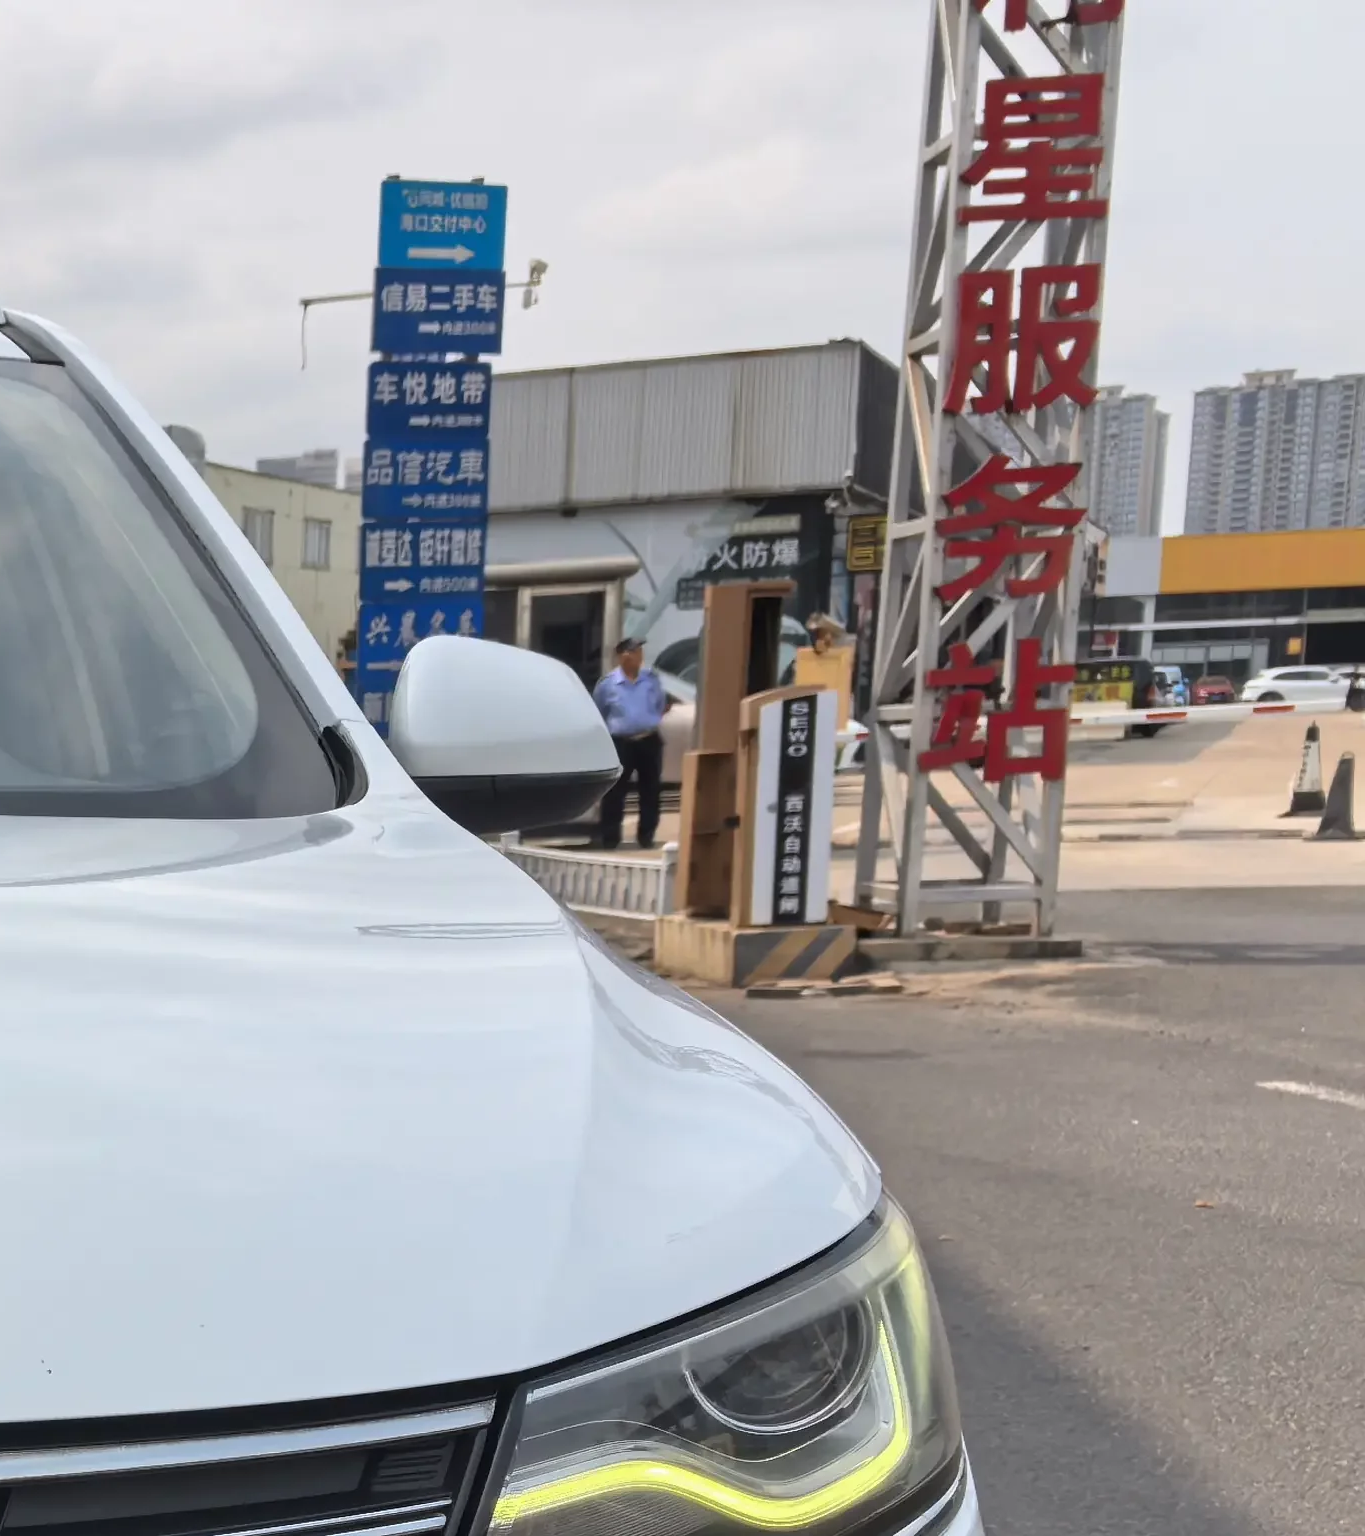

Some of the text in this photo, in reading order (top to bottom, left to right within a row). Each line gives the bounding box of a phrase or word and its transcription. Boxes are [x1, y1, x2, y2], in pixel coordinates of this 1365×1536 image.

[381, 282, 498, 313] 信易二手车
[373, 371, 486, 406] 车悦地带
[366, 448, 485, 487] 品信汽車
[786, 702, 810, 757] SEWO
